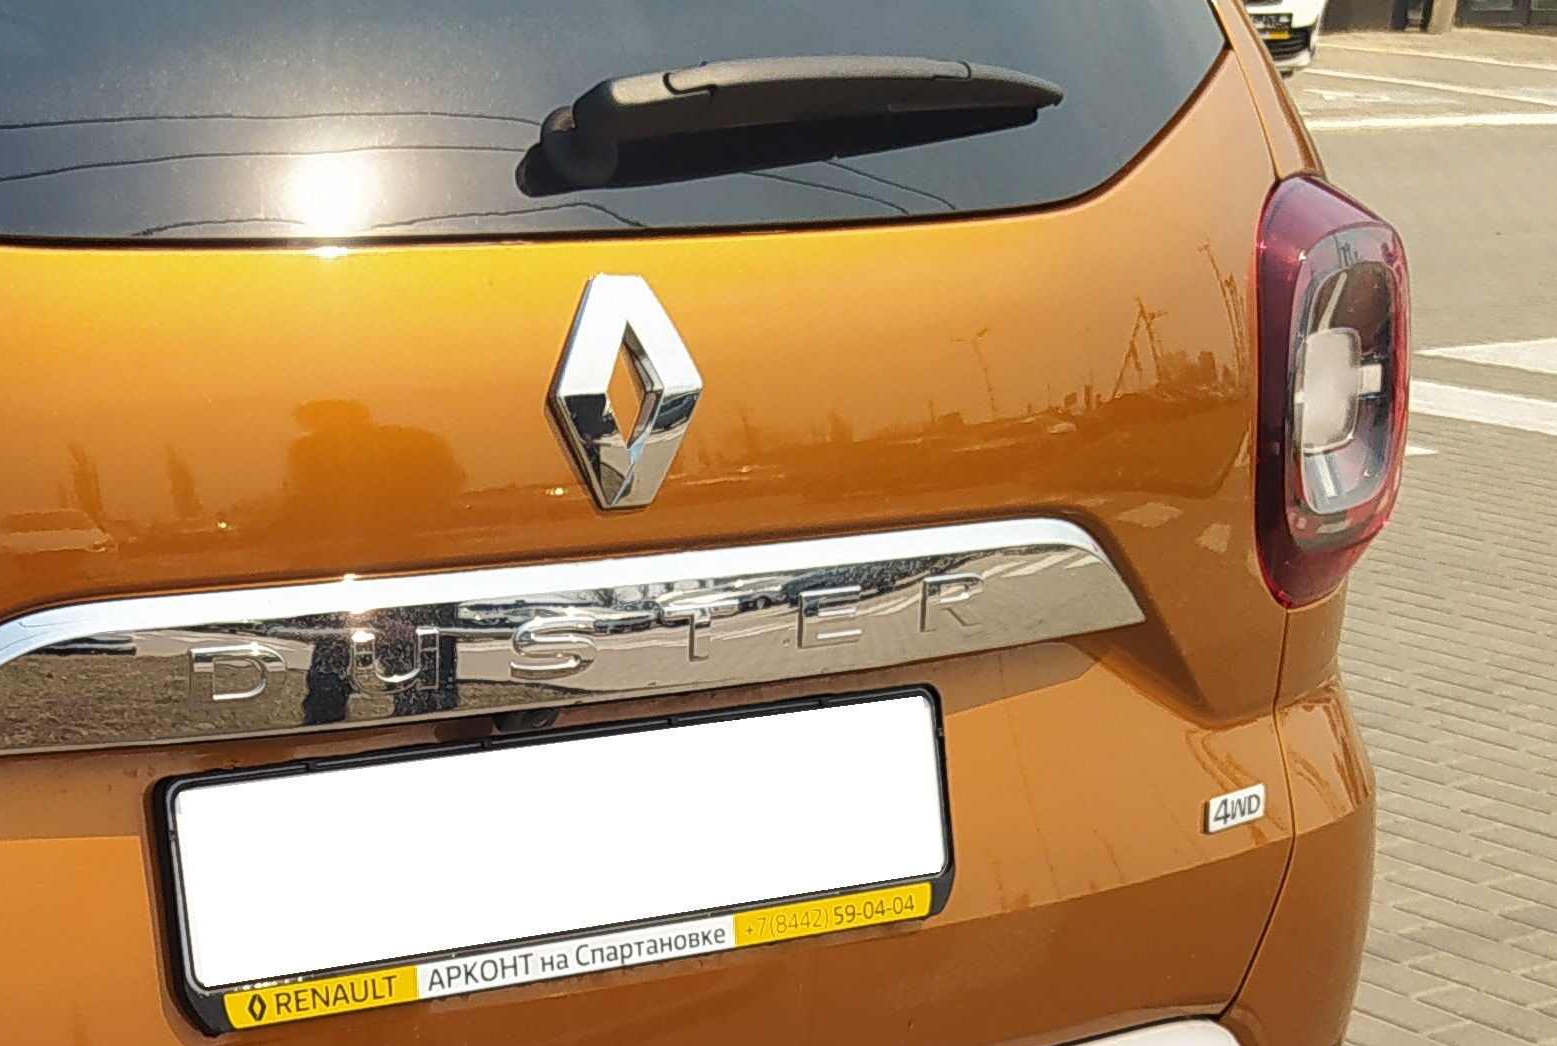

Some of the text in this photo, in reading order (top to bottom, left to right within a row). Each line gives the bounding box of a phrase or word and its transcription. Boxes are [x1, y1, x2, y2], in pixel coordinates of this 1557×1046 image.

[188, 571, 986, 701] DUSTER
[1213, 795, 1260, 824] 4WD
[428, 925, 727, 992] АРКОНТ на Спартановке
[274, 975, 397, 1016] RENAULT
